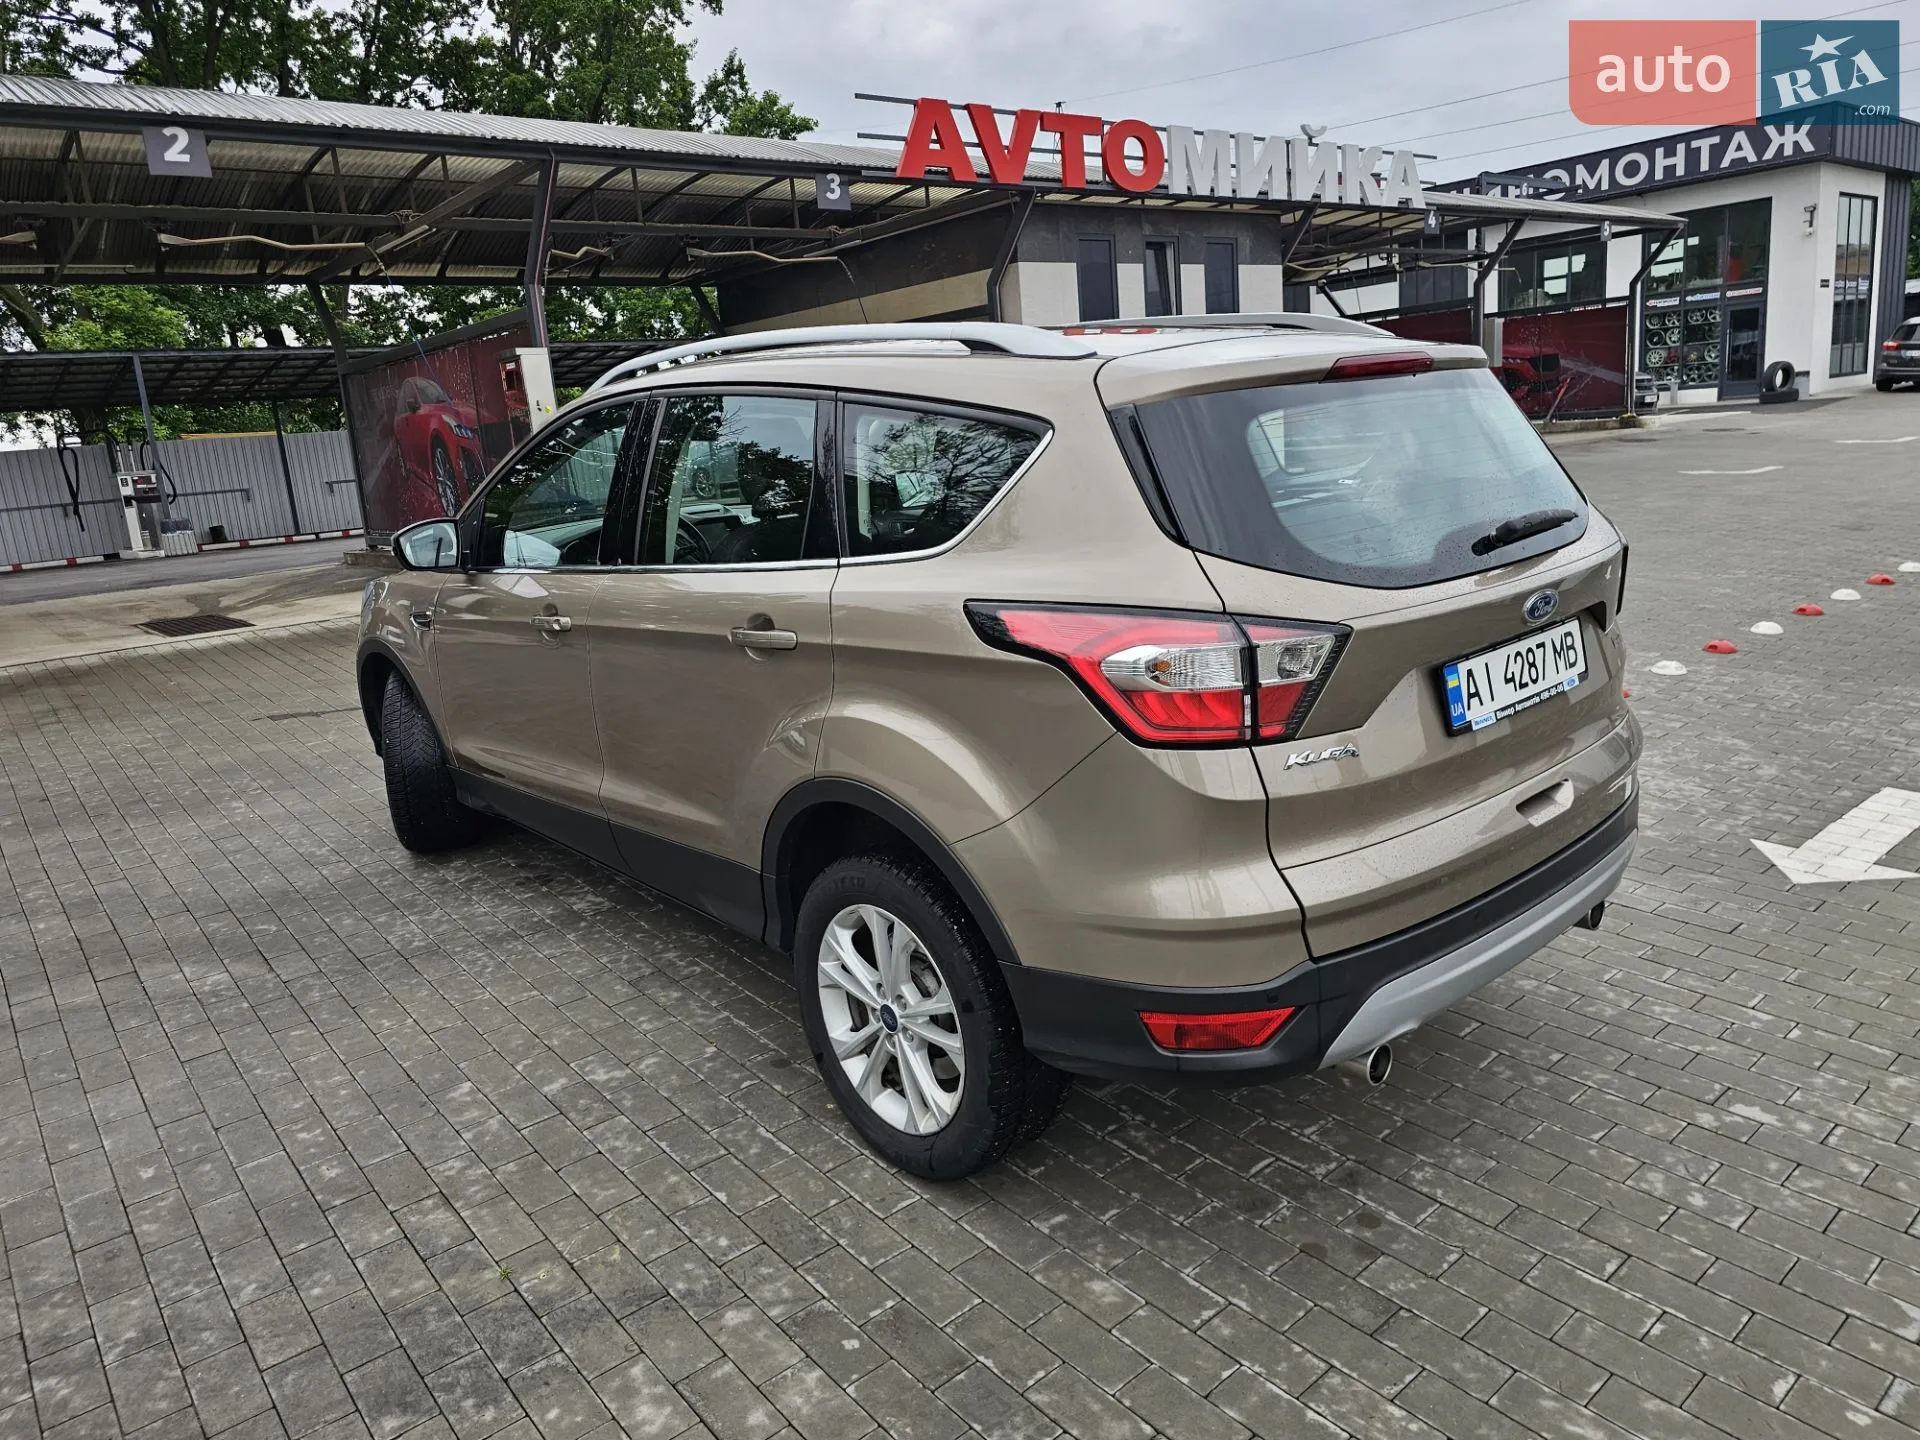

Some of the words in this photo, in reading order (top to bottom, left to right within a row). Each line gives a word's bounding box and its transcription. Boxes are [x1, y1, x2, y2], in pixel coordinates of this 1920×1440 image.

[161, 126, 191, 163] 2
[1450, 116, 1815, 200] ОМОНТАЖ
[825, 172, 841, 200] 3
[1521, 182, 1528, 196] 6
[1427, 210, 1436, 228] 4
[1603, 220, 1610, 236] 5
[1532, 595, 1555, 617] Ford
[1466, 662, 1495, 712] AI
[1503, 641, 1546, 692] 4287
[1550, 630, 1578, 675] MB
[1451, 703, 1465, 717] UA
[1283, 742, 1359, 770] KUGA
